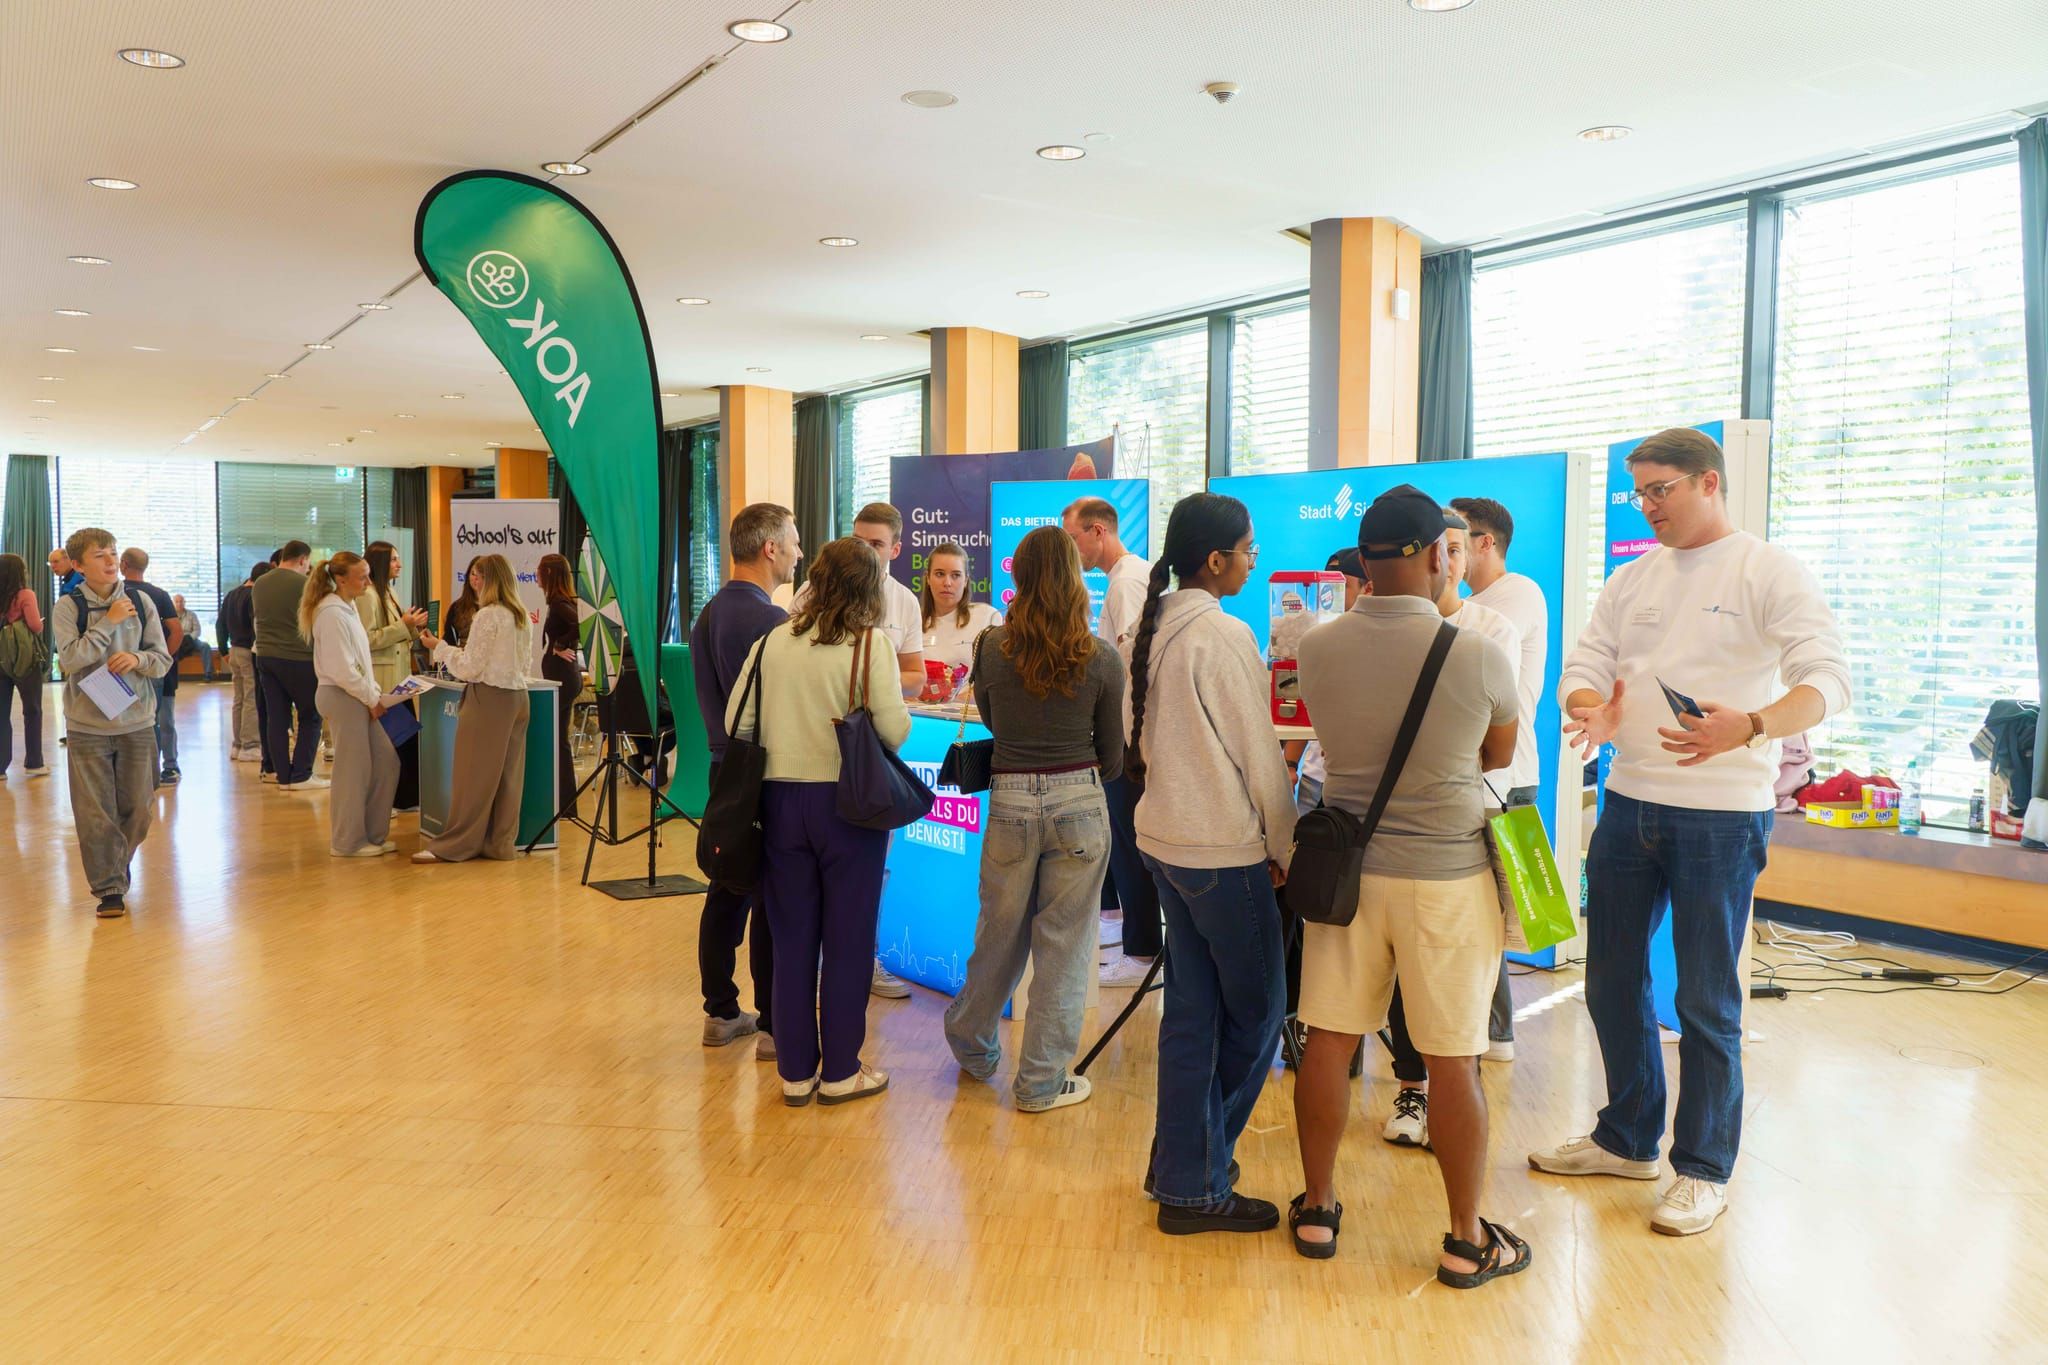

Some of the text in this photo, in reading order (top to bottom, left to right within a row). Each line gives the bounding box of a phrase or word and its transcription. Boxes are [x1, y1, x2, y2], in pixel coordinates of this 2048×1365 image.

[911, 507, 950, 525] Gut:
[1001, 516, 1022, 527] DAS
[1024, 516, 1059, 528] BIETEN
[1299, 504, 1333, 520] Stadt
[456, 523, 557, 546] School's out
[957, 803, 977, 825] DU
[907, 822, 964, 851] DENKST!
